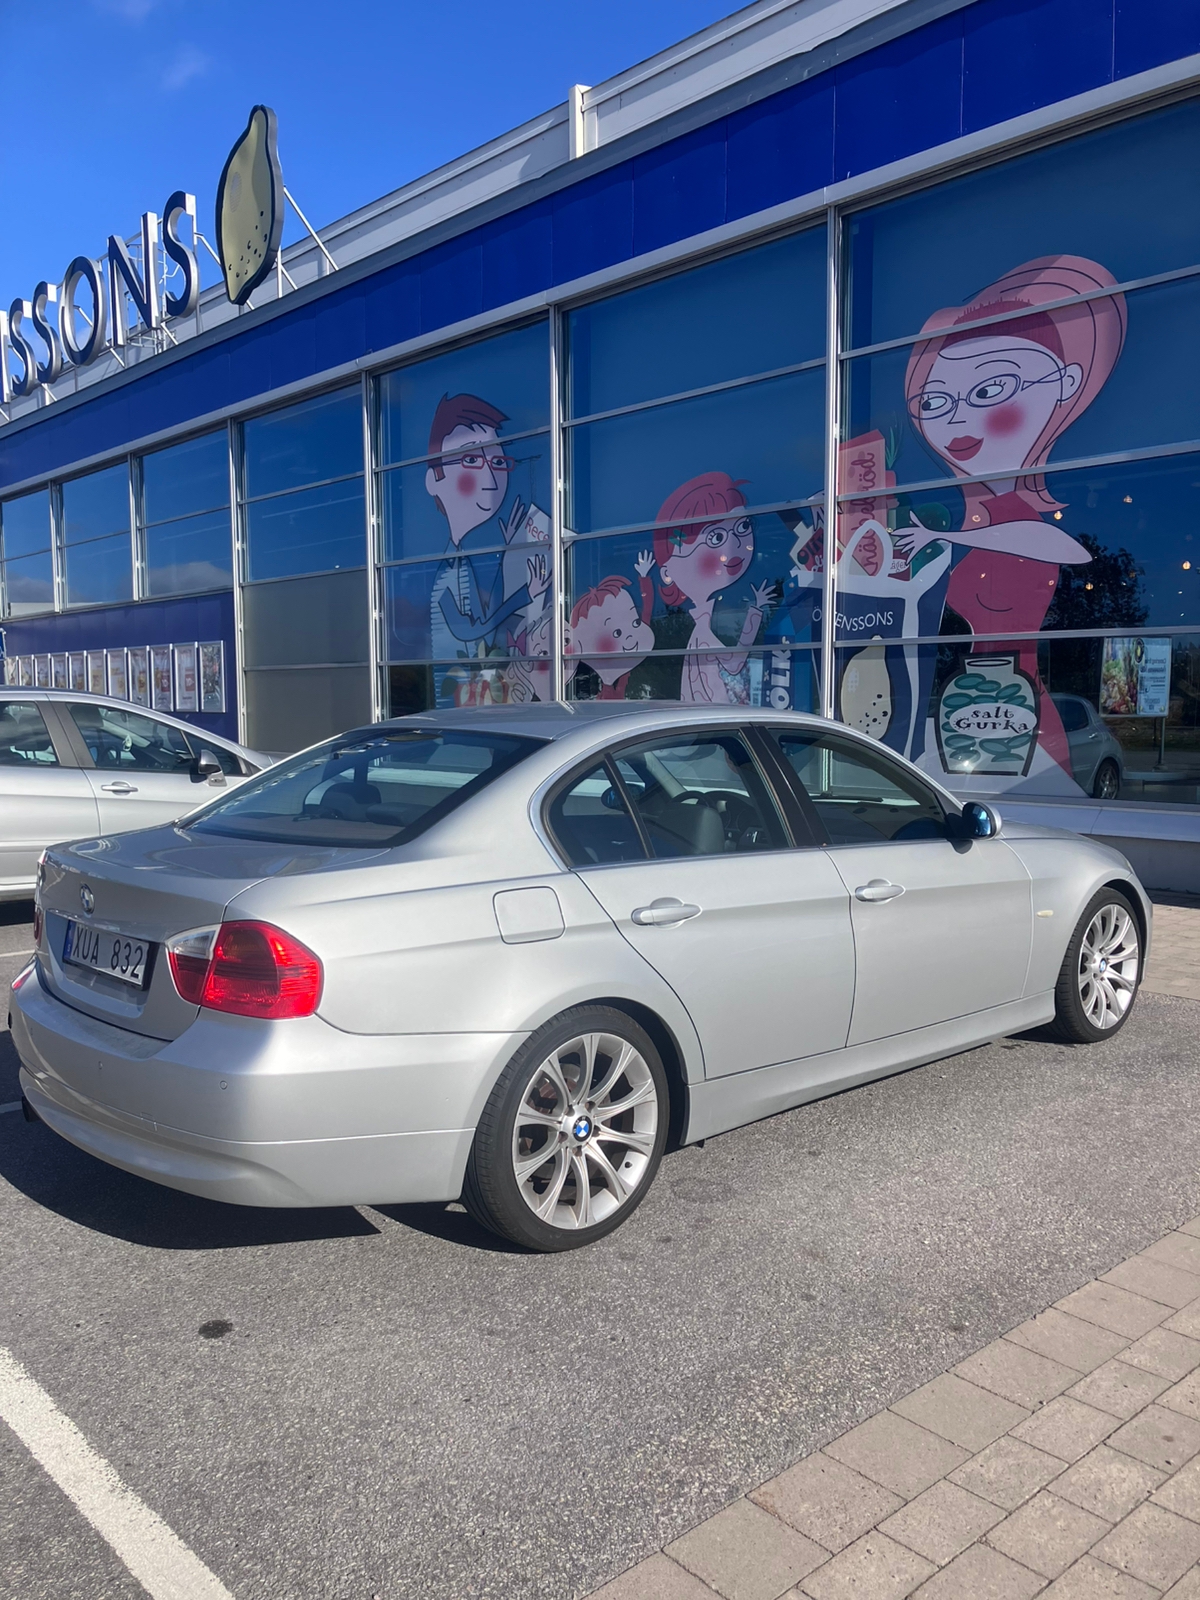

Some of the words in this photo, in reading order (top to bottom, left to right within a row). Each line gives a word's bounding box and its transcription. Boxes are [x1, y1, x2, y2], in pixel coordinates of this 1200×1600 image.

[812, 605, 894, 632] ÖENSSONS
[971, 706, 1014, 719] salt
[954, 716, 1030, 734] Gurka
[72, 926, 100, 965] XUA
[110, 938, 144, 979] 832
